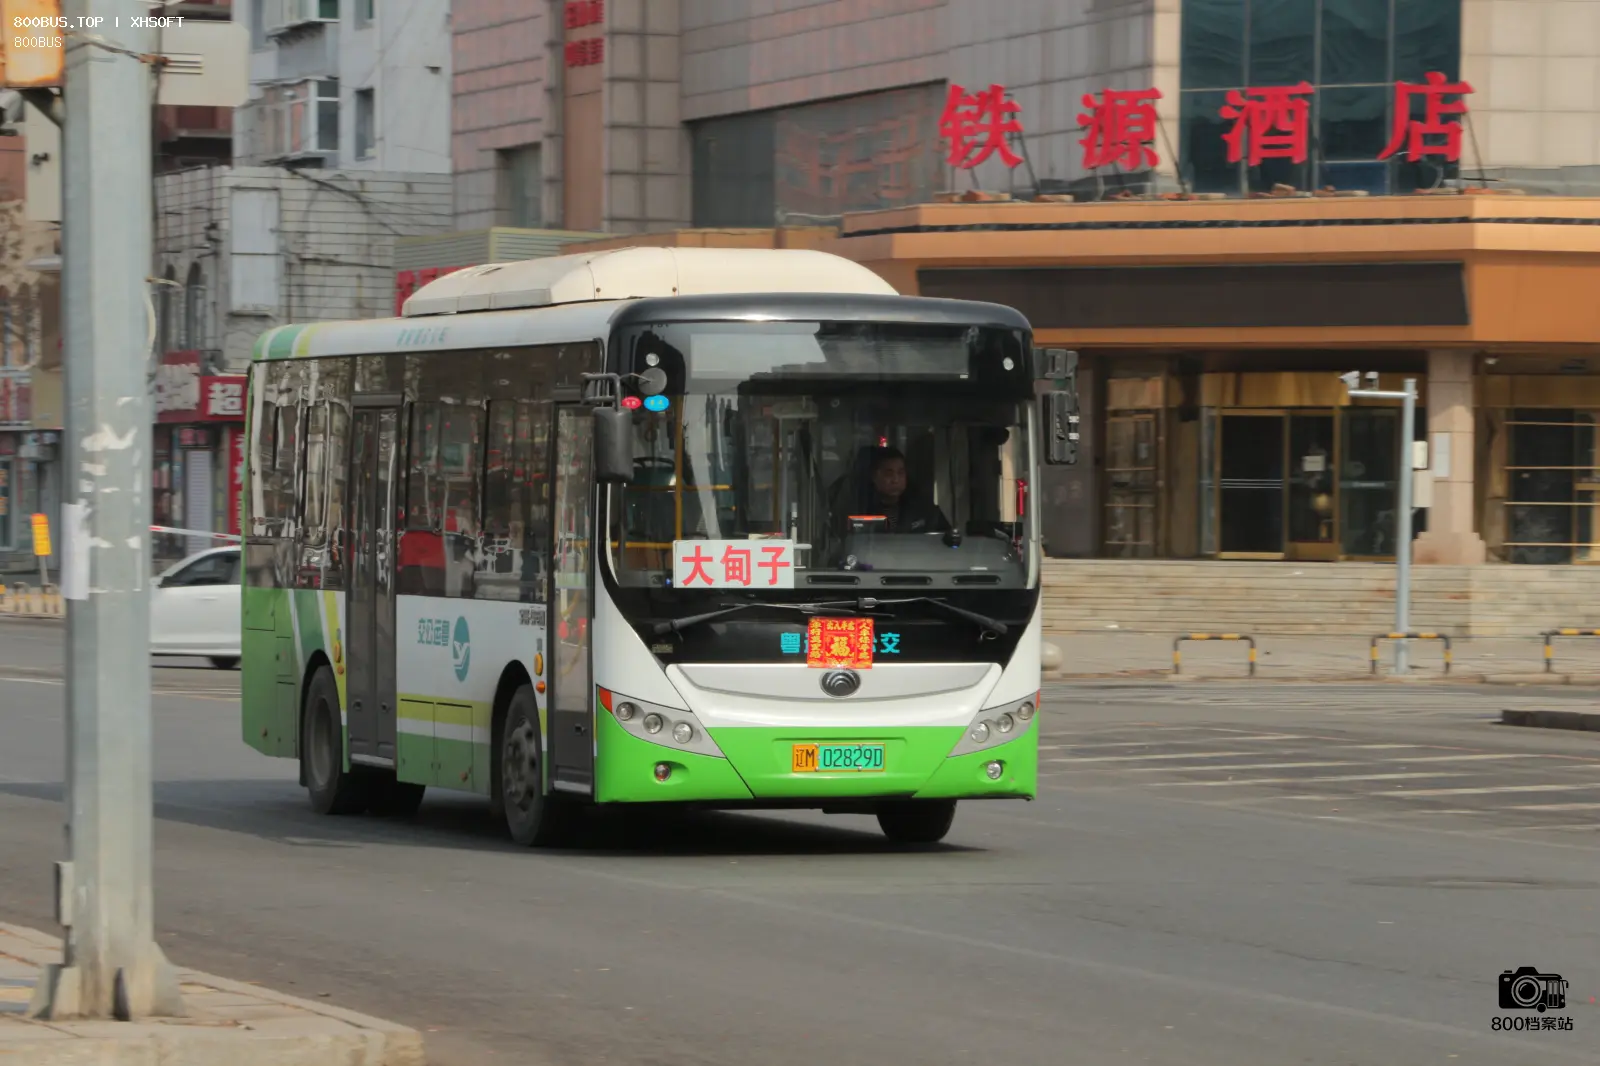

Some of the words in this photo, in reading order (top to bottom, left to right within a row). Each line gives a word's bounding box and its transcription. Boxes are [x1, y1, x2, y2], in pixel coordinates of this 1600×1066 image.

[938, 70, 1475, 170] 铁源酒店
[206, 382, 243, 416] 超
[681, 544, 791, 587] 大甸子
[823, 747, 883, 768] 02829D
